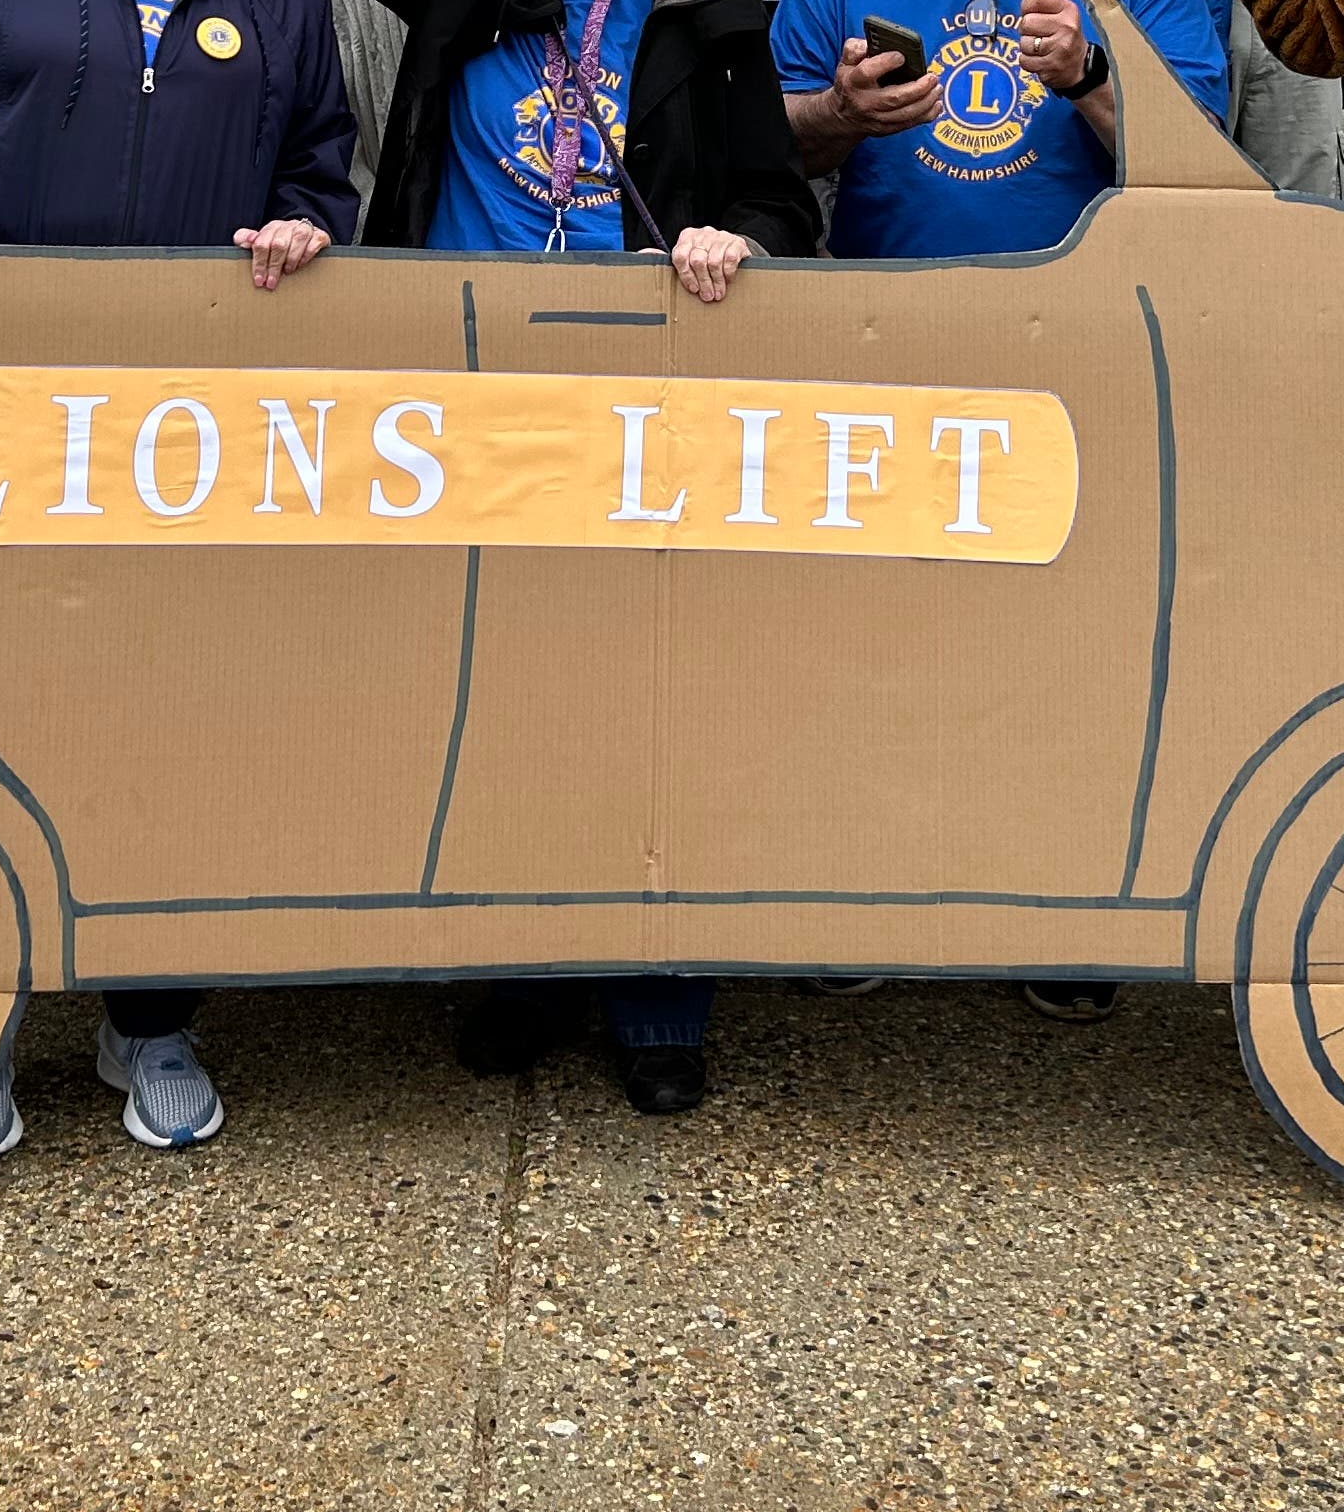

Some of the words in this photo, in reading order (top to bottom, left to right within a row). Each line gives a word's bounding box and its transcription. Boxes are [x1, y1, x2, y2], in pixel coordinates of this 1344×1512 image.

[949, 37, 1020, 63] LIONS
[966, 70, 1000, 114] L
[940, 123, 1017, 149] INTERNATIONAL
[914, 146, 946, 173] NEW
[946, 149, 1040, 181] HAMPSHIRE
[528, 185, 622, 209] HAPSHIRE
[607, 402, 1012, 537] LIFT
